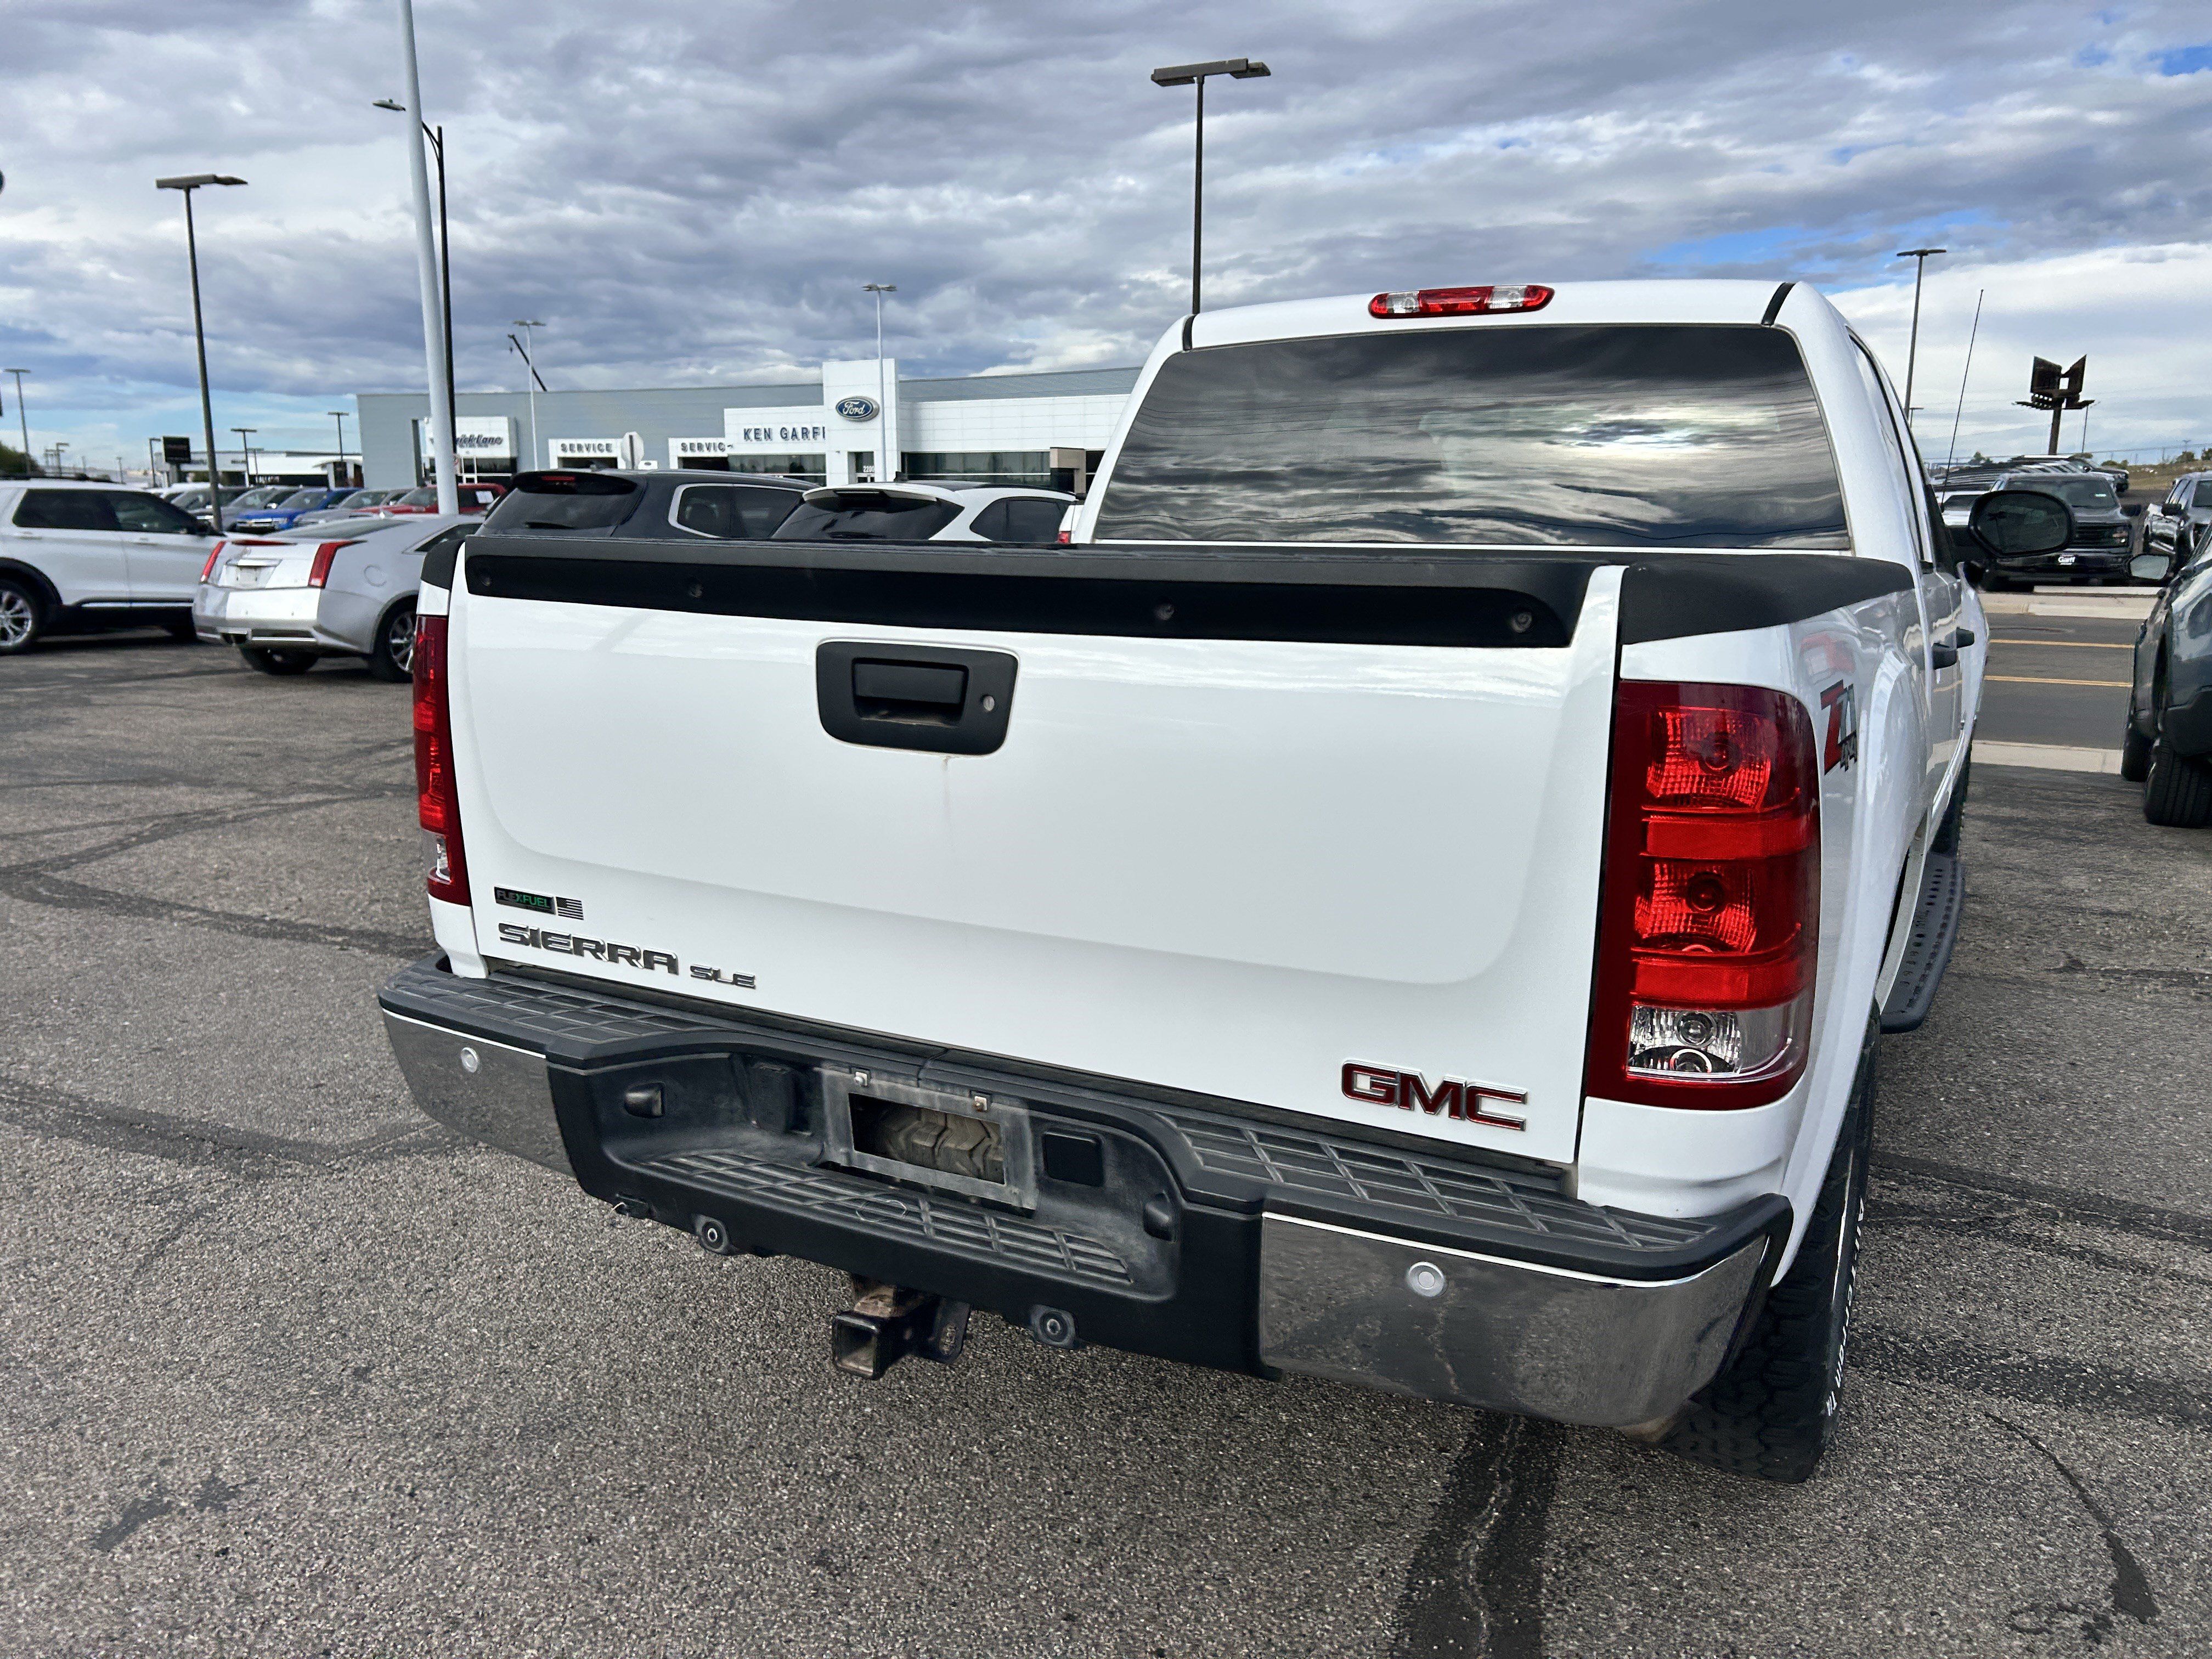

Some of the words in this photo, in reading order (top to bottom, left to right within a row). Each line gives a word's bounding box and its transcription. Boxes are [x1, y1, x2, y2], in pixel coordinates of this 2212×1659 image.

[843, 401, 865, 414] Ford
[743, 427, 772, 441] KEN
[561, 443, 612, 453] SERVICE
[681, 442, 733, 453] SERVIC
[496, 889, 550, 908] FLEXFUEL
[498, 922, 679, 975] SIERRA
[690, 963, 757, 989] SLE
[1341, 1059, 1528, 1132] GMC
